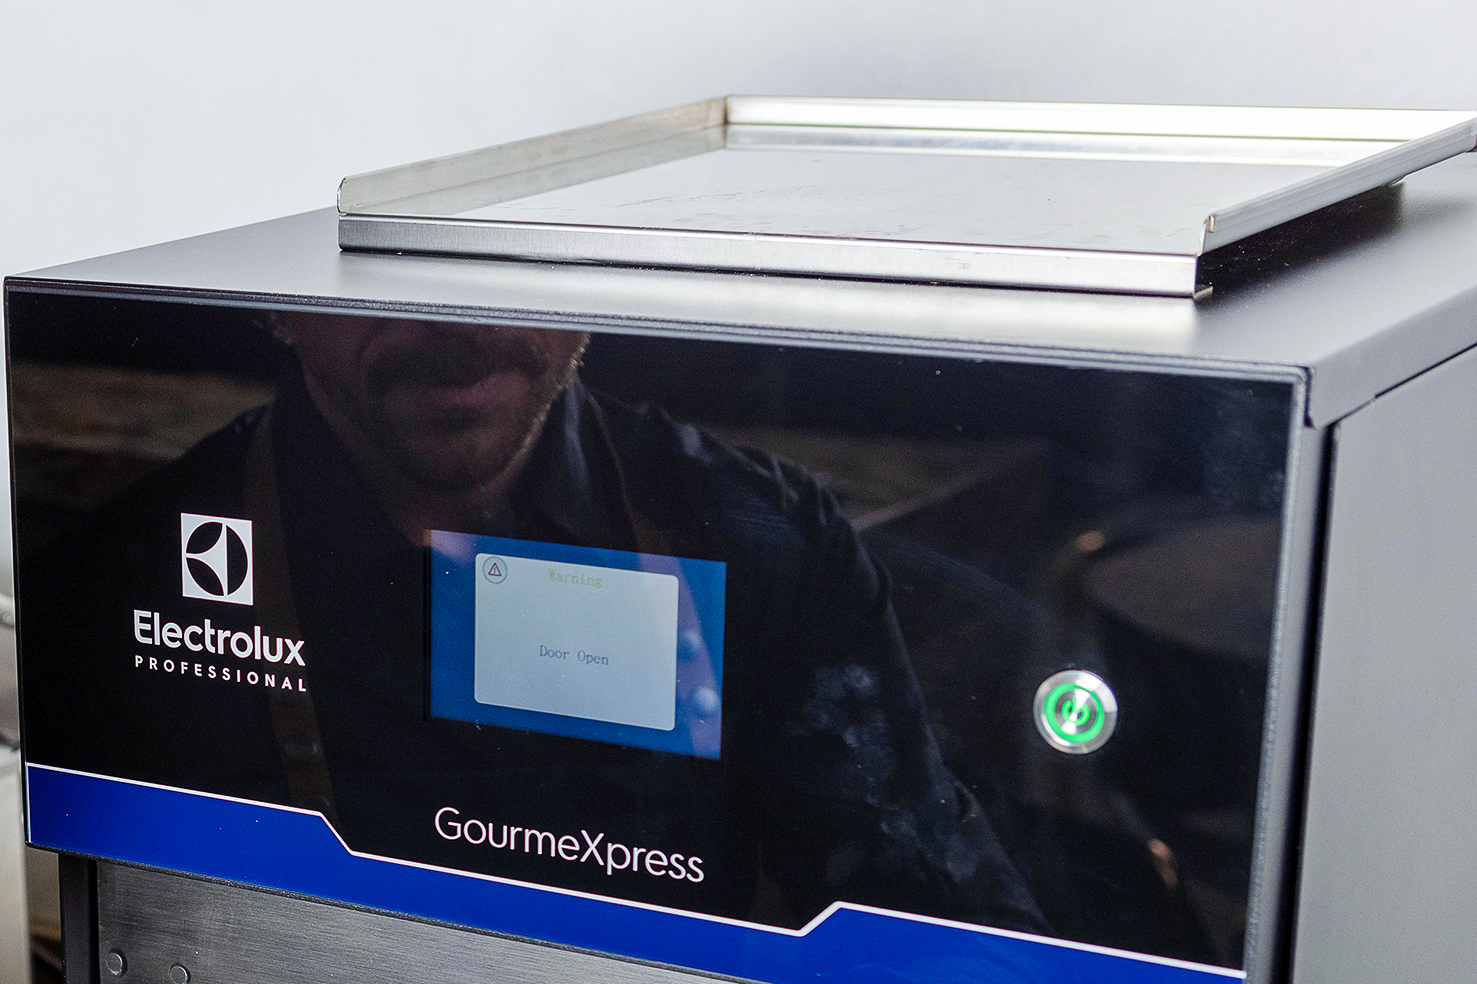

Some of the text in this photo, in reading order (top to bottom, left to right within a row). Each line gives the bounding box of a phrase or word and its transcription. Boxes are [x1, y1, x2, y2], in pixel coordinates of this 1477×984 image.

[548, 568, 603, 588] Warning
[133, 609, 306, 667] Electrolux
[539, 645, 609, 666] Door Open
[134, 655, 307, 692] PROFESSIONAL
[434, 806, 705, 883] GourmeXpress
